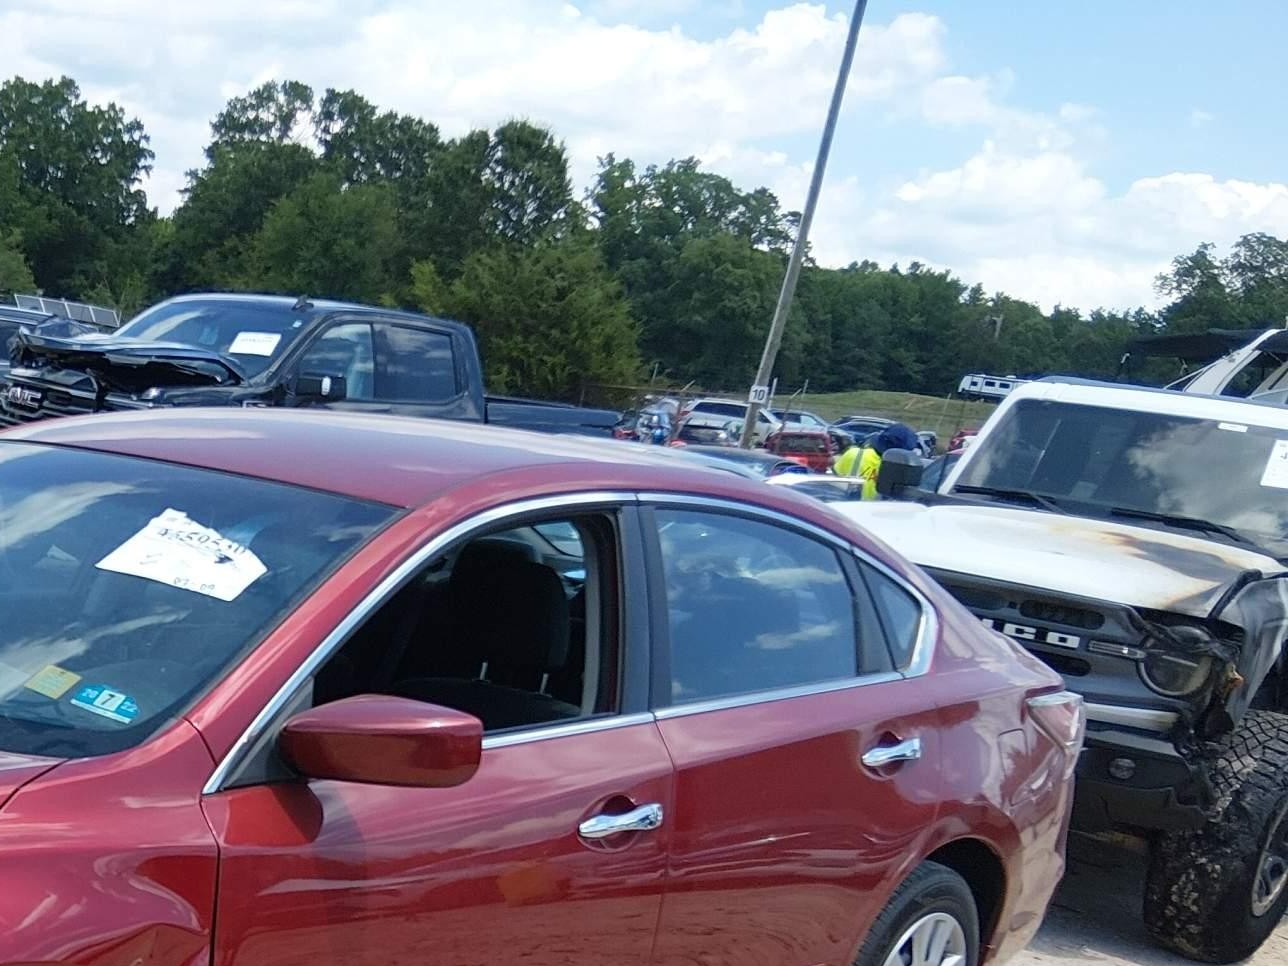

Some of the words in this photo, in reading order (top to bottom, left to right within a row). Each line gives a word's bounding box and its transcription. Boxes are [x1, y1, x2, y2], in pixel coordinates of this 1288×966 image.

[752, 389, 766, 401] 10
[982, 618, 1081, 649] CO
[100, 693, 116, 706] 7
